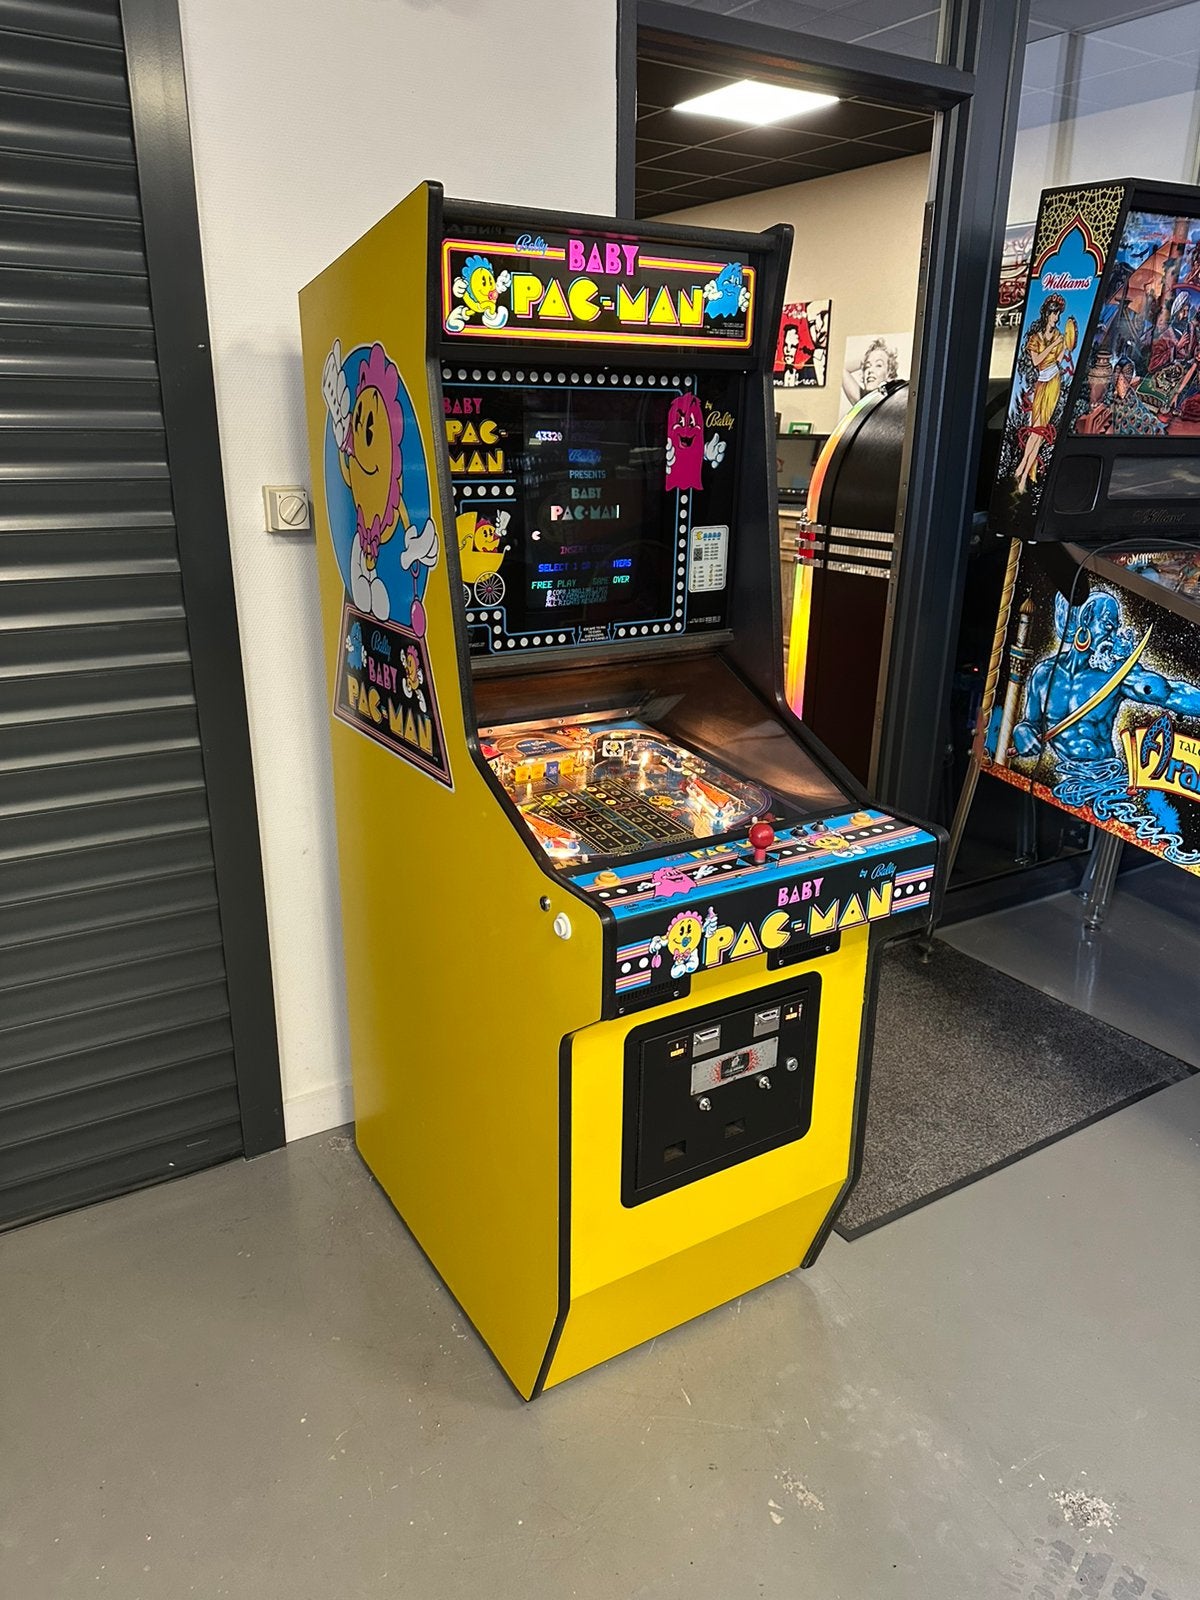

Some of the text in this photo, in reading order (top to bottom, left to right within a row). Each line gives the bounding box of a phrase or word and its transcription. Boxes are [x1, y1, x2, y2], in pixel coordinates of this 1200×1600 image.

[514, 233, 549, 256] Bally
[569, 239, 640, 275] BABY
[1042, 271, 1092, 290] Williams
[511, 271, 704, 328] PAC-MAN
[442, 397, 482, 414] BABY
[705, 400, 713, 410] by
[706, 411, 735, 430] Bally
[445, 418, 508, 444] PAC-
[535, 428, 563, 441] 43320
[448, 448, 505, 473] MAN
[569, 470, 606, 479] PRESENTS
[571, 487, 601, 499] BABY
[538, 563, 568, 573] SELECT
[531, 579, 577, 590] FREE PLAY
[612, 575, 631, 584] OVER
[371, 630, 392, 661] Bally
[367, 656, 398, 693] BABY
[346, 674, 434, 757] PAC-MAN
[1140, 712, 1200, 796] Ara
[1179, 739, 1200, 758] TAL
[871, 862, 897, 880] Bally
[777, 878, 825, 907] BABY
[701, 881, 893, 969] PAC-MAN
